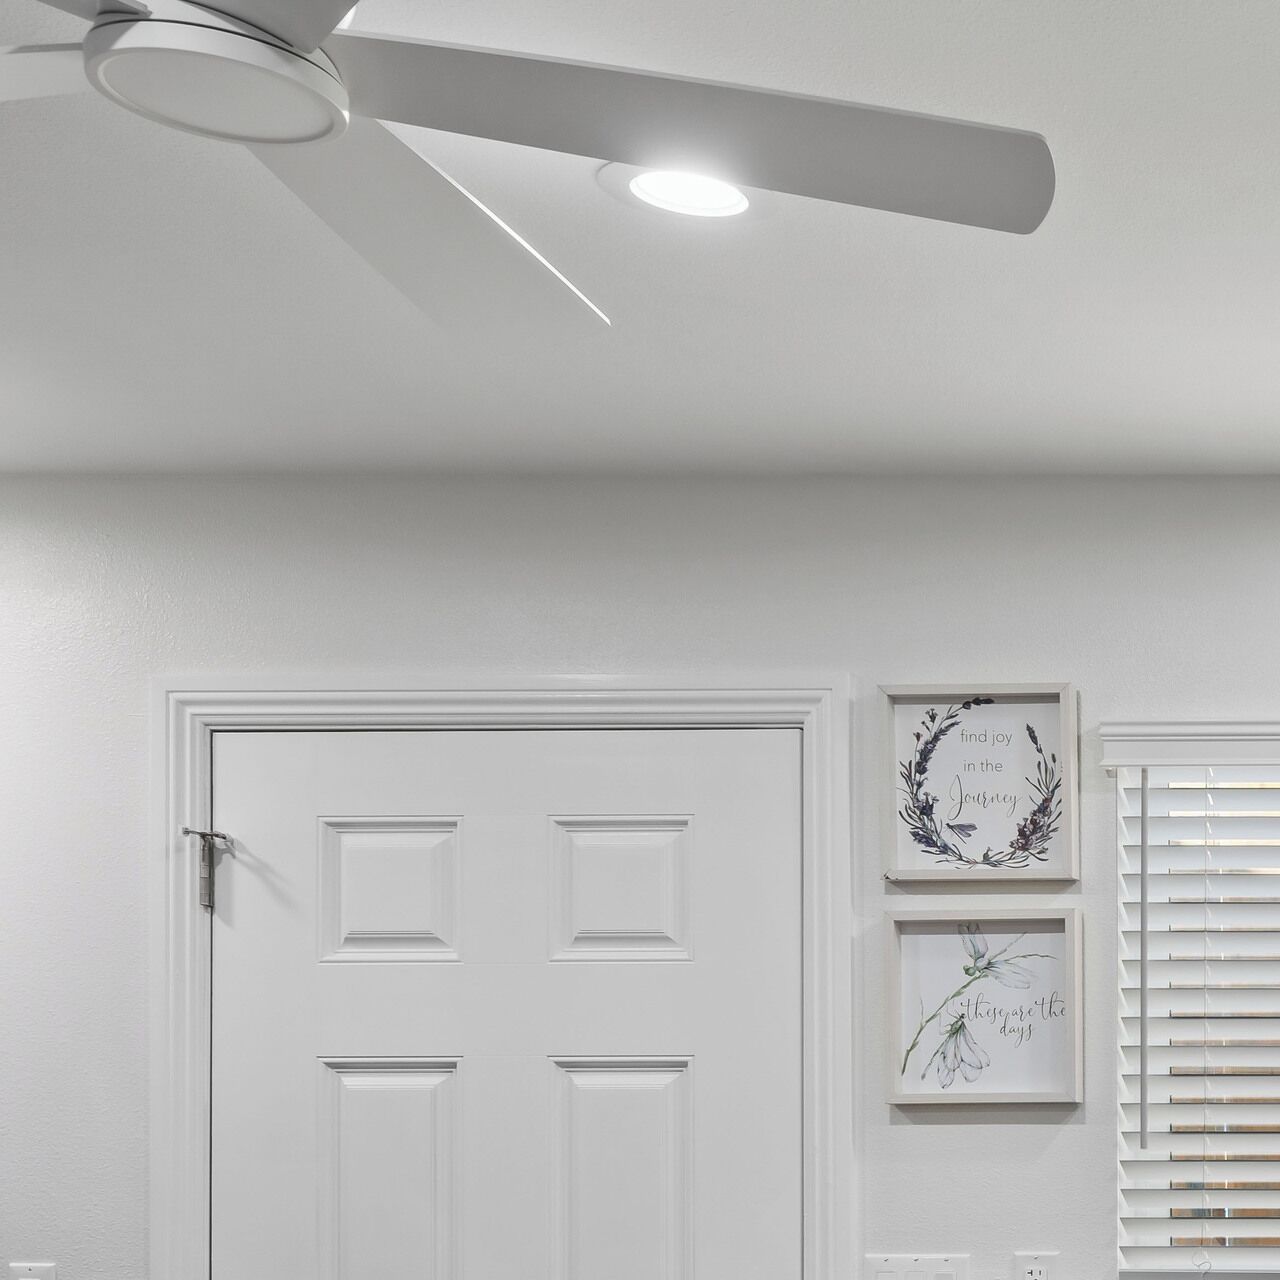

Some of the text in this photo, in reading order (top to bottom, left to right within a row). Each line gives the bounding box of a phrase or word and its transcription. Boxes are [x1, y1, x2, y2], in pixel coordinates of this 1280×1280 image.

[960, 728, 1013, 747] find joy
[963, 758, 1003, 773] in the
[960, 992, 1004, 1024] these
[1011, 1005, 1034, 1022] are
[1000, 1010, 1033, 1048] days
